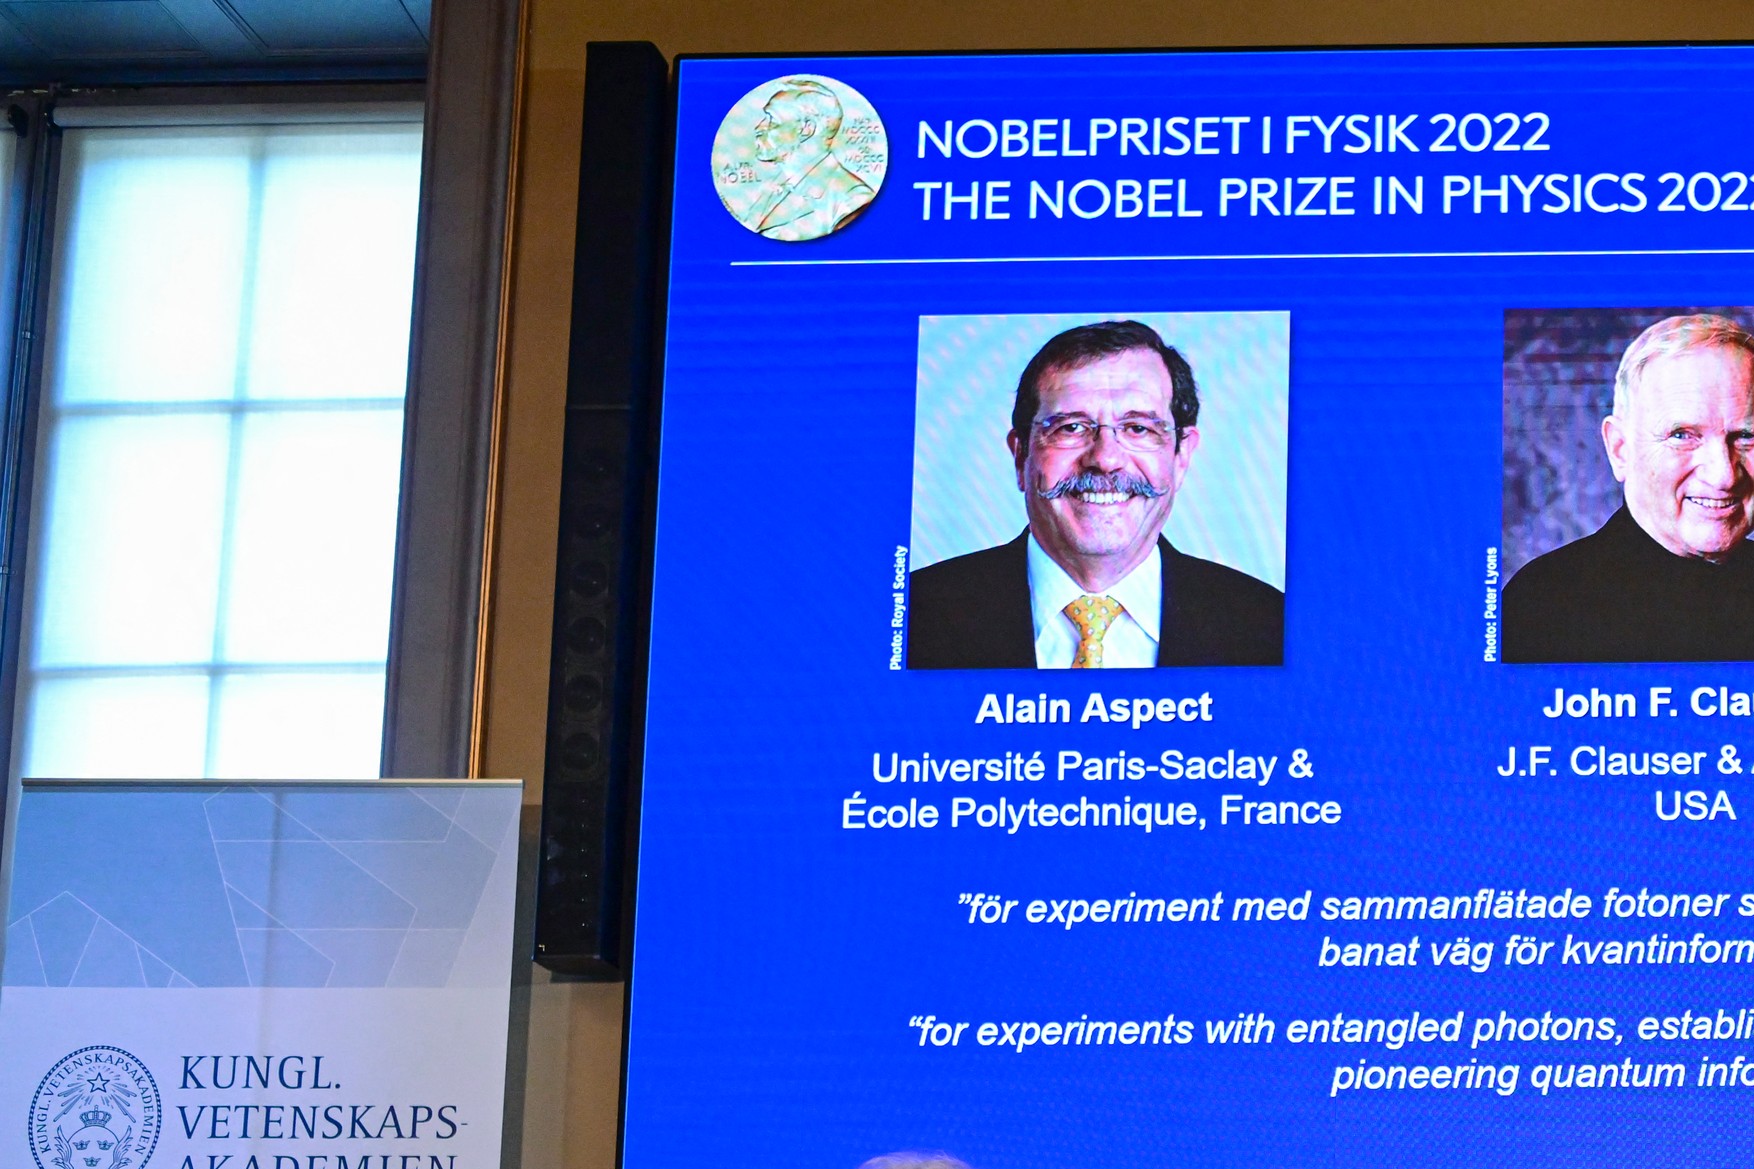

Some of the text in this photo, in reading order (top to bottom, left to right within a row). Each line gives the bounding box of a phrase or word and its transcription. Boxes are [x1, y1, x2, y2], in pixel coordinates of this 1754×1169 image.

[918, 113, 1550, 158] NOBELPRISET I FYSIK 2022
[914, 181, 1010, 220] THE
[1030, 179, 1202, 218] NOBEL
[1220, 177, 1355, 216] PRIZE
[1375, 176, 1422, 214] IN
[1444, 173, 1647, 213] PHYSICS
[890, 545, 908, 670] Photo: Royal Society
[1484, 547, 1499, 662] Photo: Peter Lyons
[975, 692, 1212, 729] Alain Aspect
[1543, 688, 1636, 717] John
[1650, 687, 1677, 716] F.
[873, 749, 1313, 786] Université Paris-Saclay &
[1497, 746, 1556, 776] J.F.
[1571, 746, 1707, 775] Clauser
[1717, 745, 1743, 774] &
[843, 791, 1341, 834] École Polytechnique, France
[1656, 790, 1736, 820] USA
[959, 893, 1019, 923] ”för
[1026, 892, 1223, 930] experiment
[1232, 890, 1312, 921] med
[1321, 888, 1592, 920] sammanflätade
[1604, 887, 1731, 917] fotoner
[1319, 936, 1420, 966] banat
[1431, 937, 1494, 972] väg
[1505, 935, 1555, 965] för
[909, 1016, 969, 1046] “for
[977, 1014, 1194, 1053] experiments
[1206, 1013, 1275, 1043] with
[1287, 1011, 1464, 1049] entangled
[1471, 1011, 1622, 1049] photons,
[179, 1056, 341, 1090] KUNGL.
[1330, 1058, 1520, 1097] pioneering
[1531, 1057, 1685, 1095] quantum
[37, 1053, 154, 1154] KUNGL. VETENSKAPSAKADEMIEN
[178, 1105, 468, 1140] VETENSKAPS-
